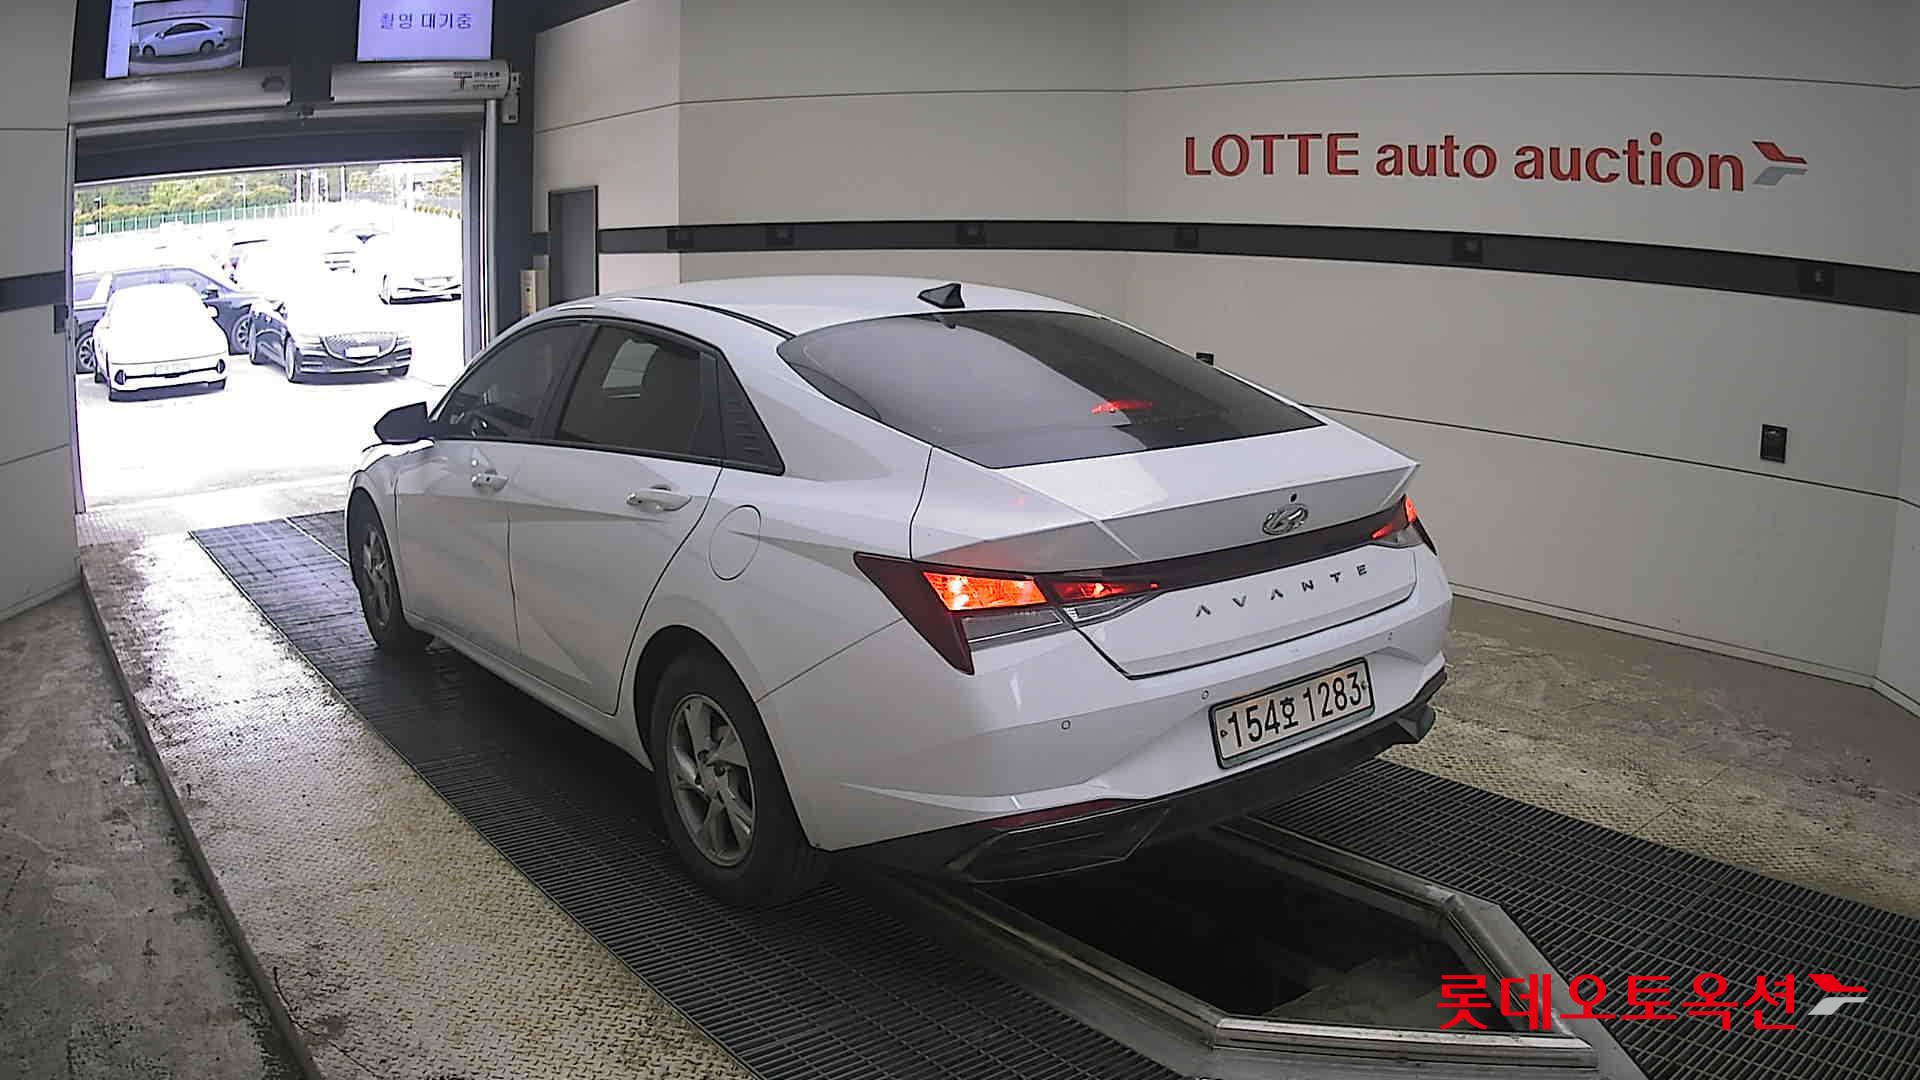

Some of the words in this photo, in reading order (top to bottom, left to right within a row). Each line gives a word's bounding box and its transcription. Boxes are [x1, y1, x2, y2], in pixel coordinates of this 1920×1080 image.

[421, 12, 473, 30] 대기중
[1184, 133, 1361, 178] LOTTE
[1375, 135, 1498, 178] auto
[1514, 133, 1745, 191] auction
[1194, 564, 1368, 618] AVANTE
[1227, 696, 1299, 748] 154호
[1303, 671, 1363, 723] 1283
